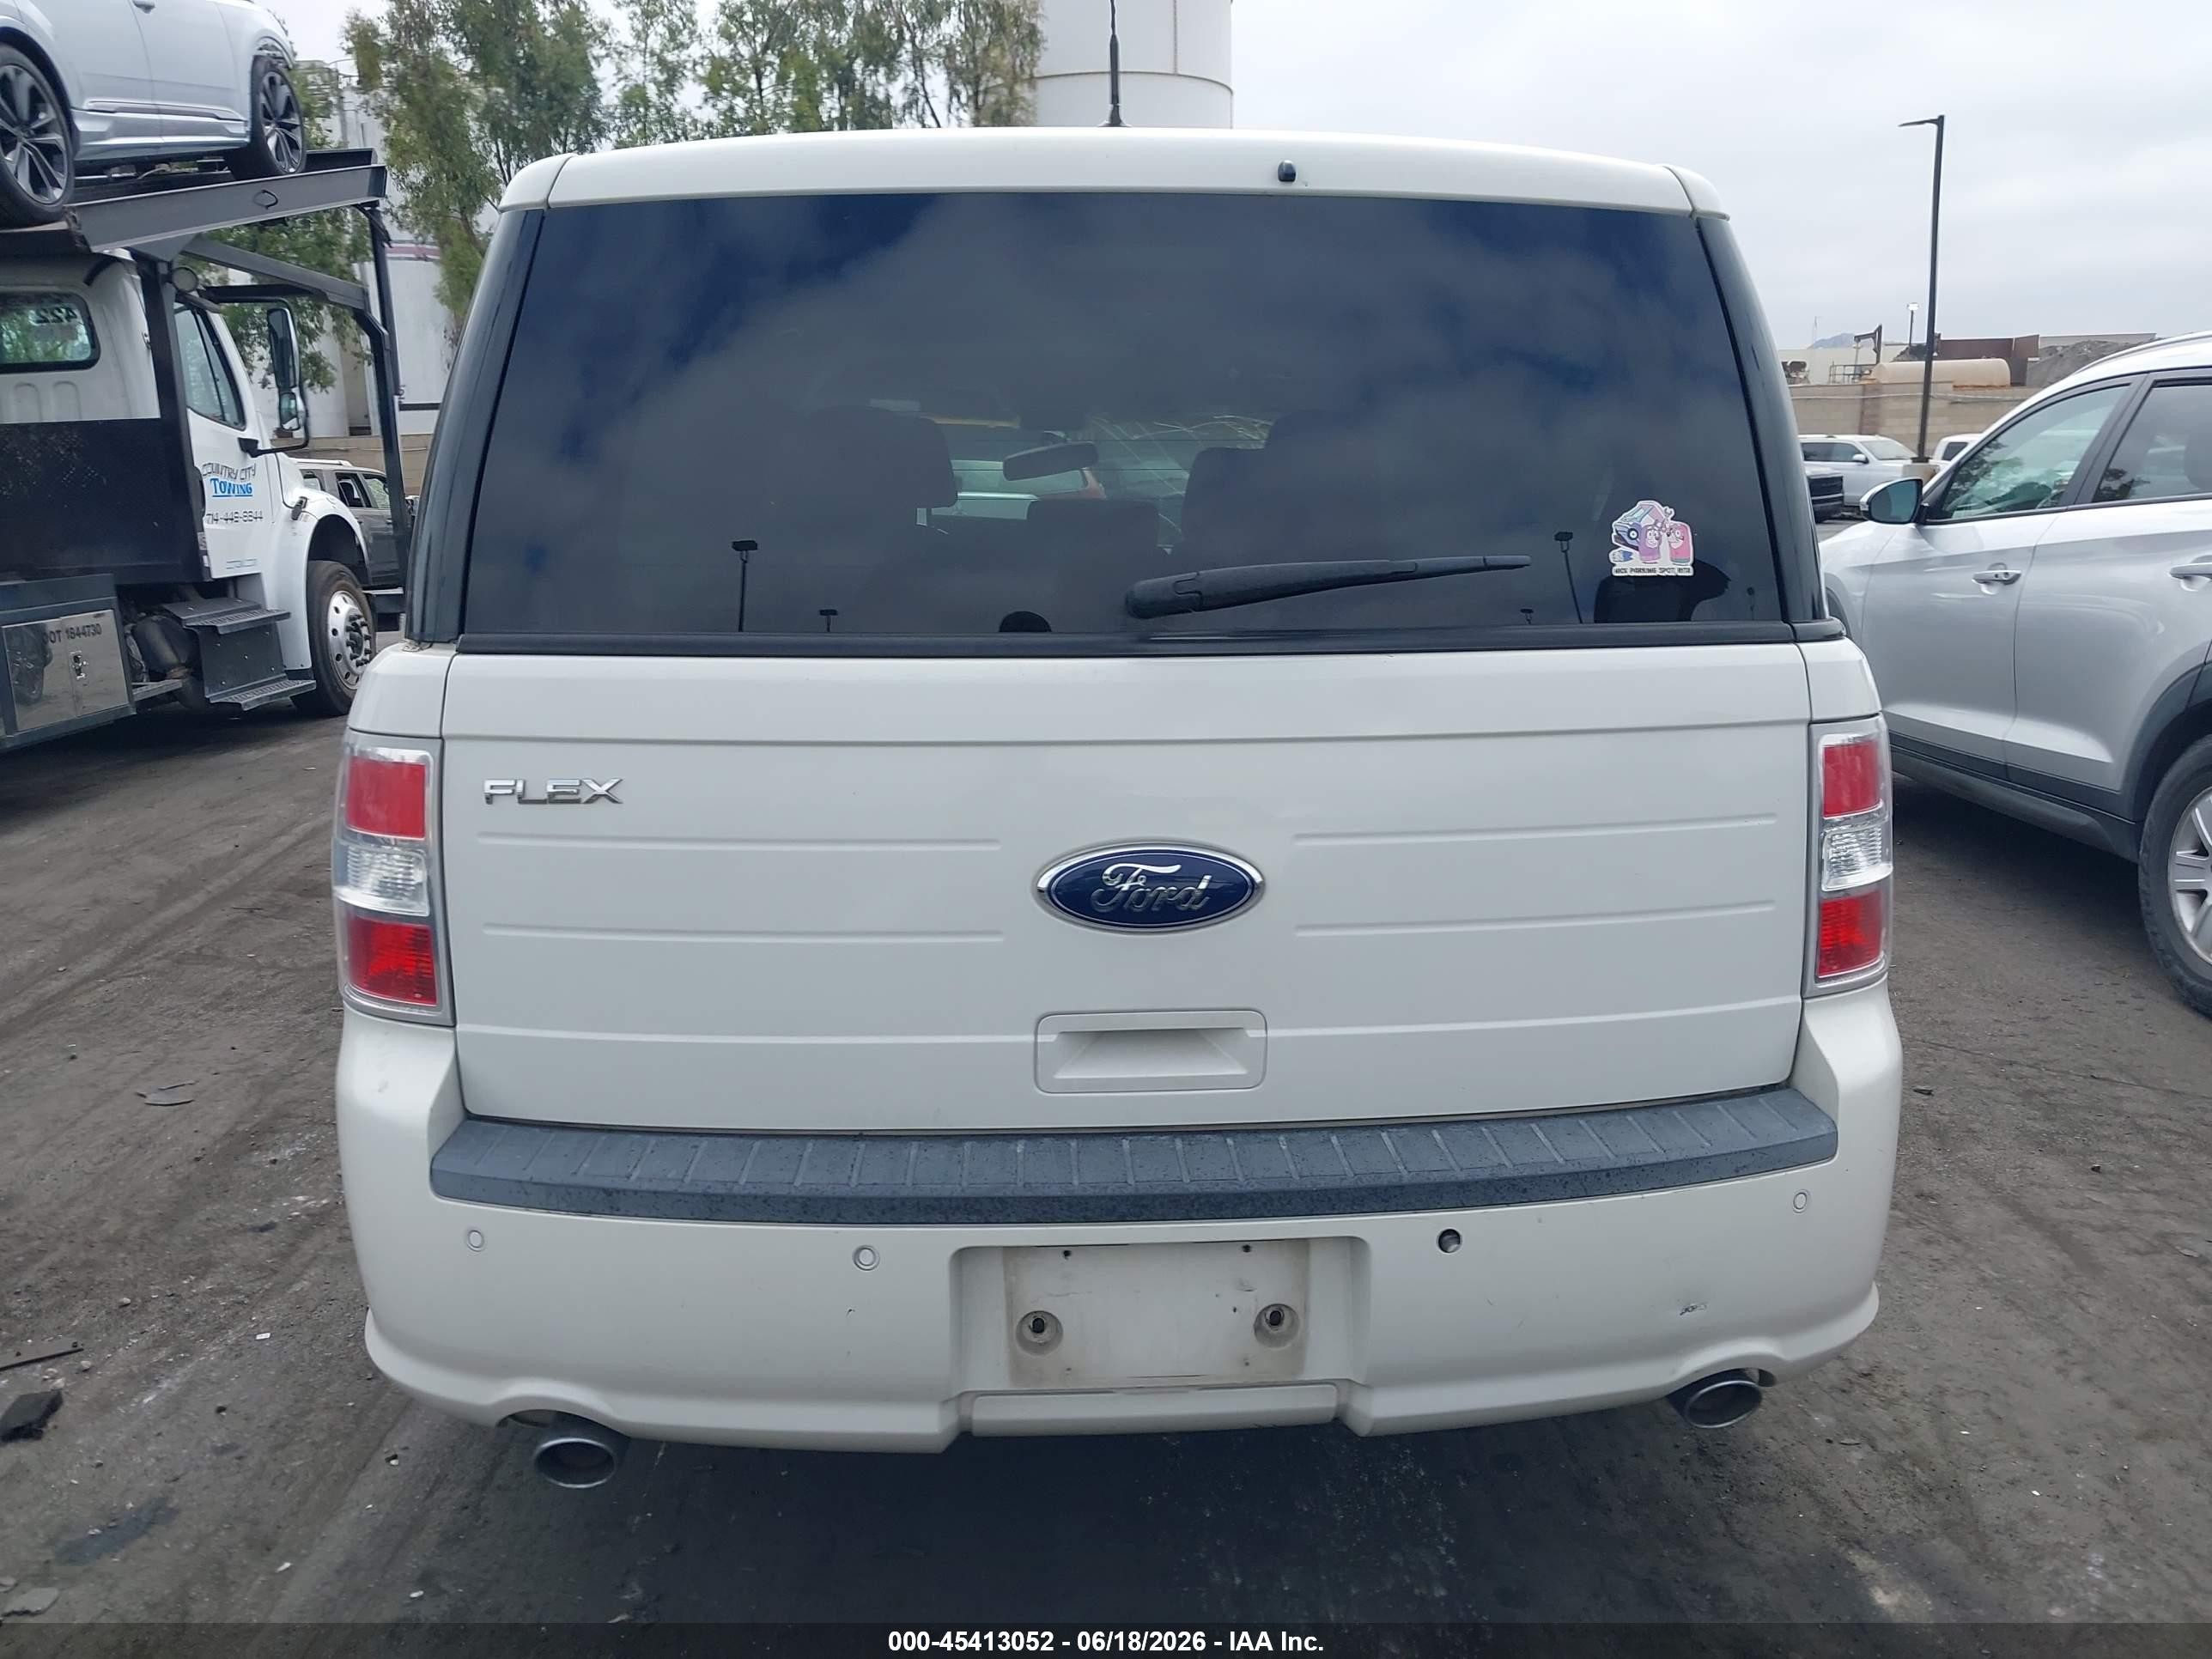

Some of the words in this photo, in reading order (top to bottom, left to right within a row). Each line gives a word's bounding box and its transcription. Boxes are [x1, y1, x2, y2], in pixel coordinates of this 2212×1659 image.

[240, 463, 257, 481] CITY
[210, 477, 253, 495] TOWING
[483, 778, 623, 805] FLEX
[1090, 862, 1213, 913] Ford
